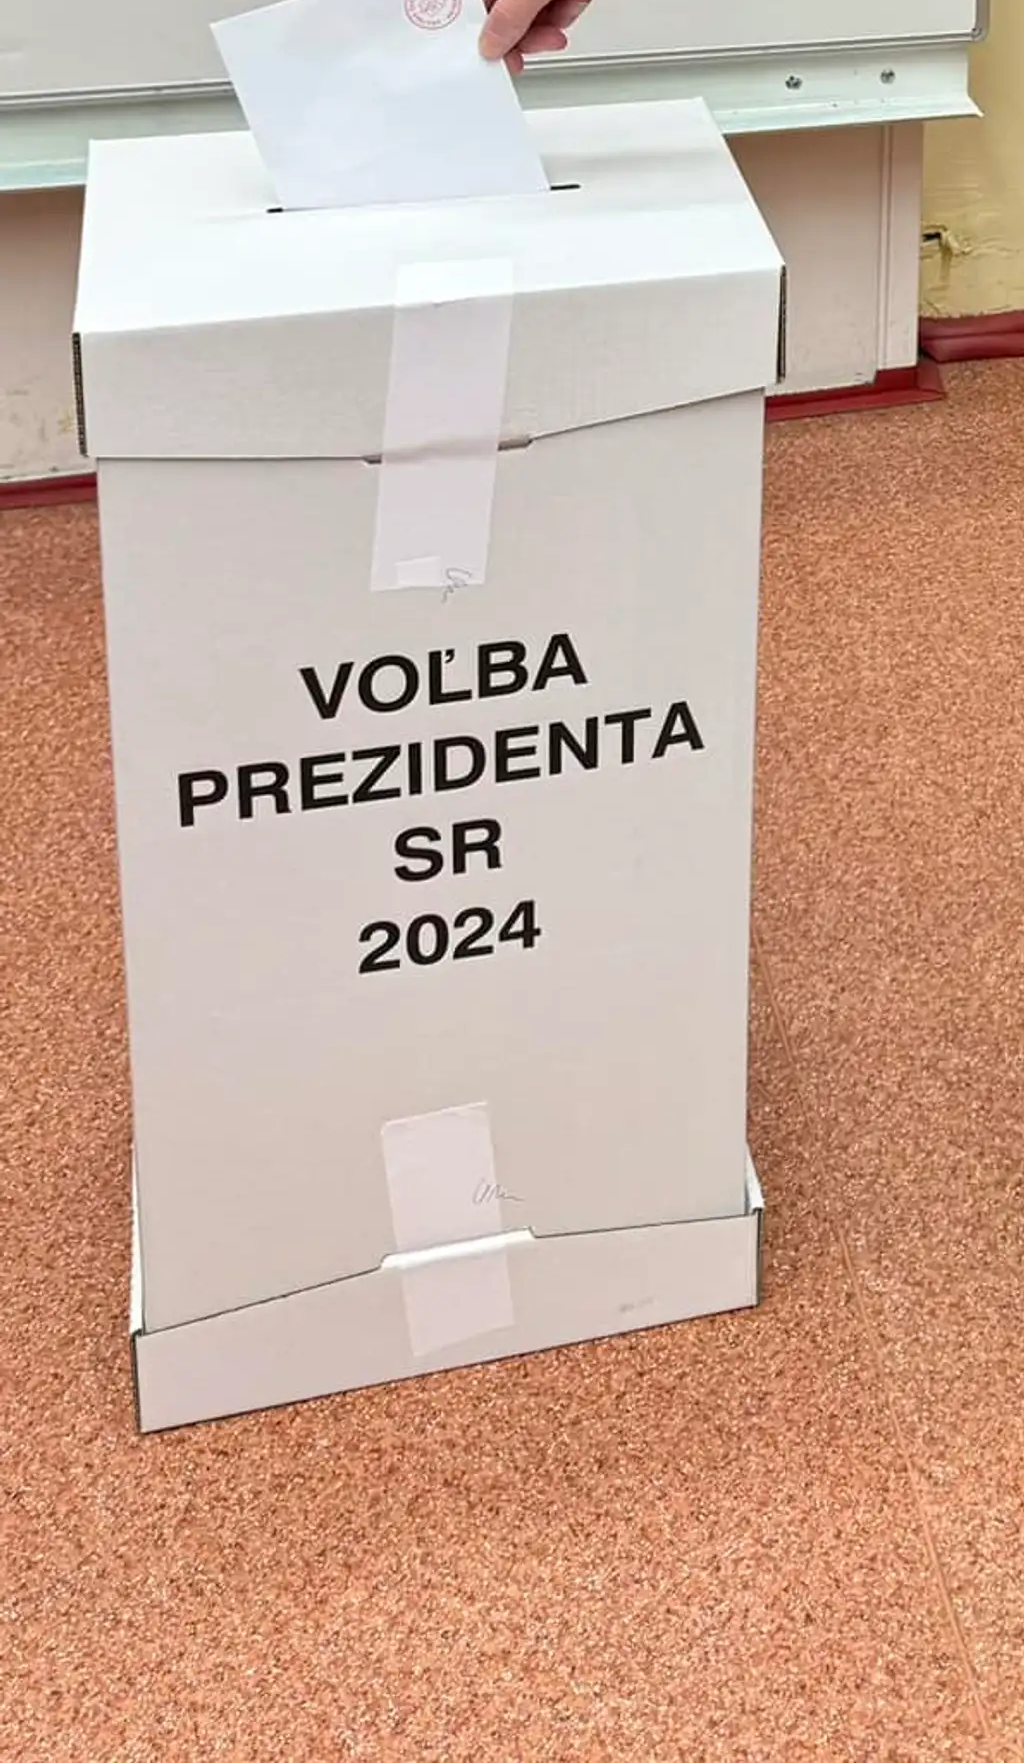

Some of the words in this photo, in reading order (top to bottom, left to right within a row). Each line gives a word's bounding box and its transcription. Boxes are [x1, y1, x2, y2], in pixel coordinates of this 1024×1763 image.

[300, 634, 587, 719] VOĽBA
[179, 702, 704, 827] PREZIDENTA
[394, 819, 502, 882] SR
[359, 900, 541, 974] 2024
